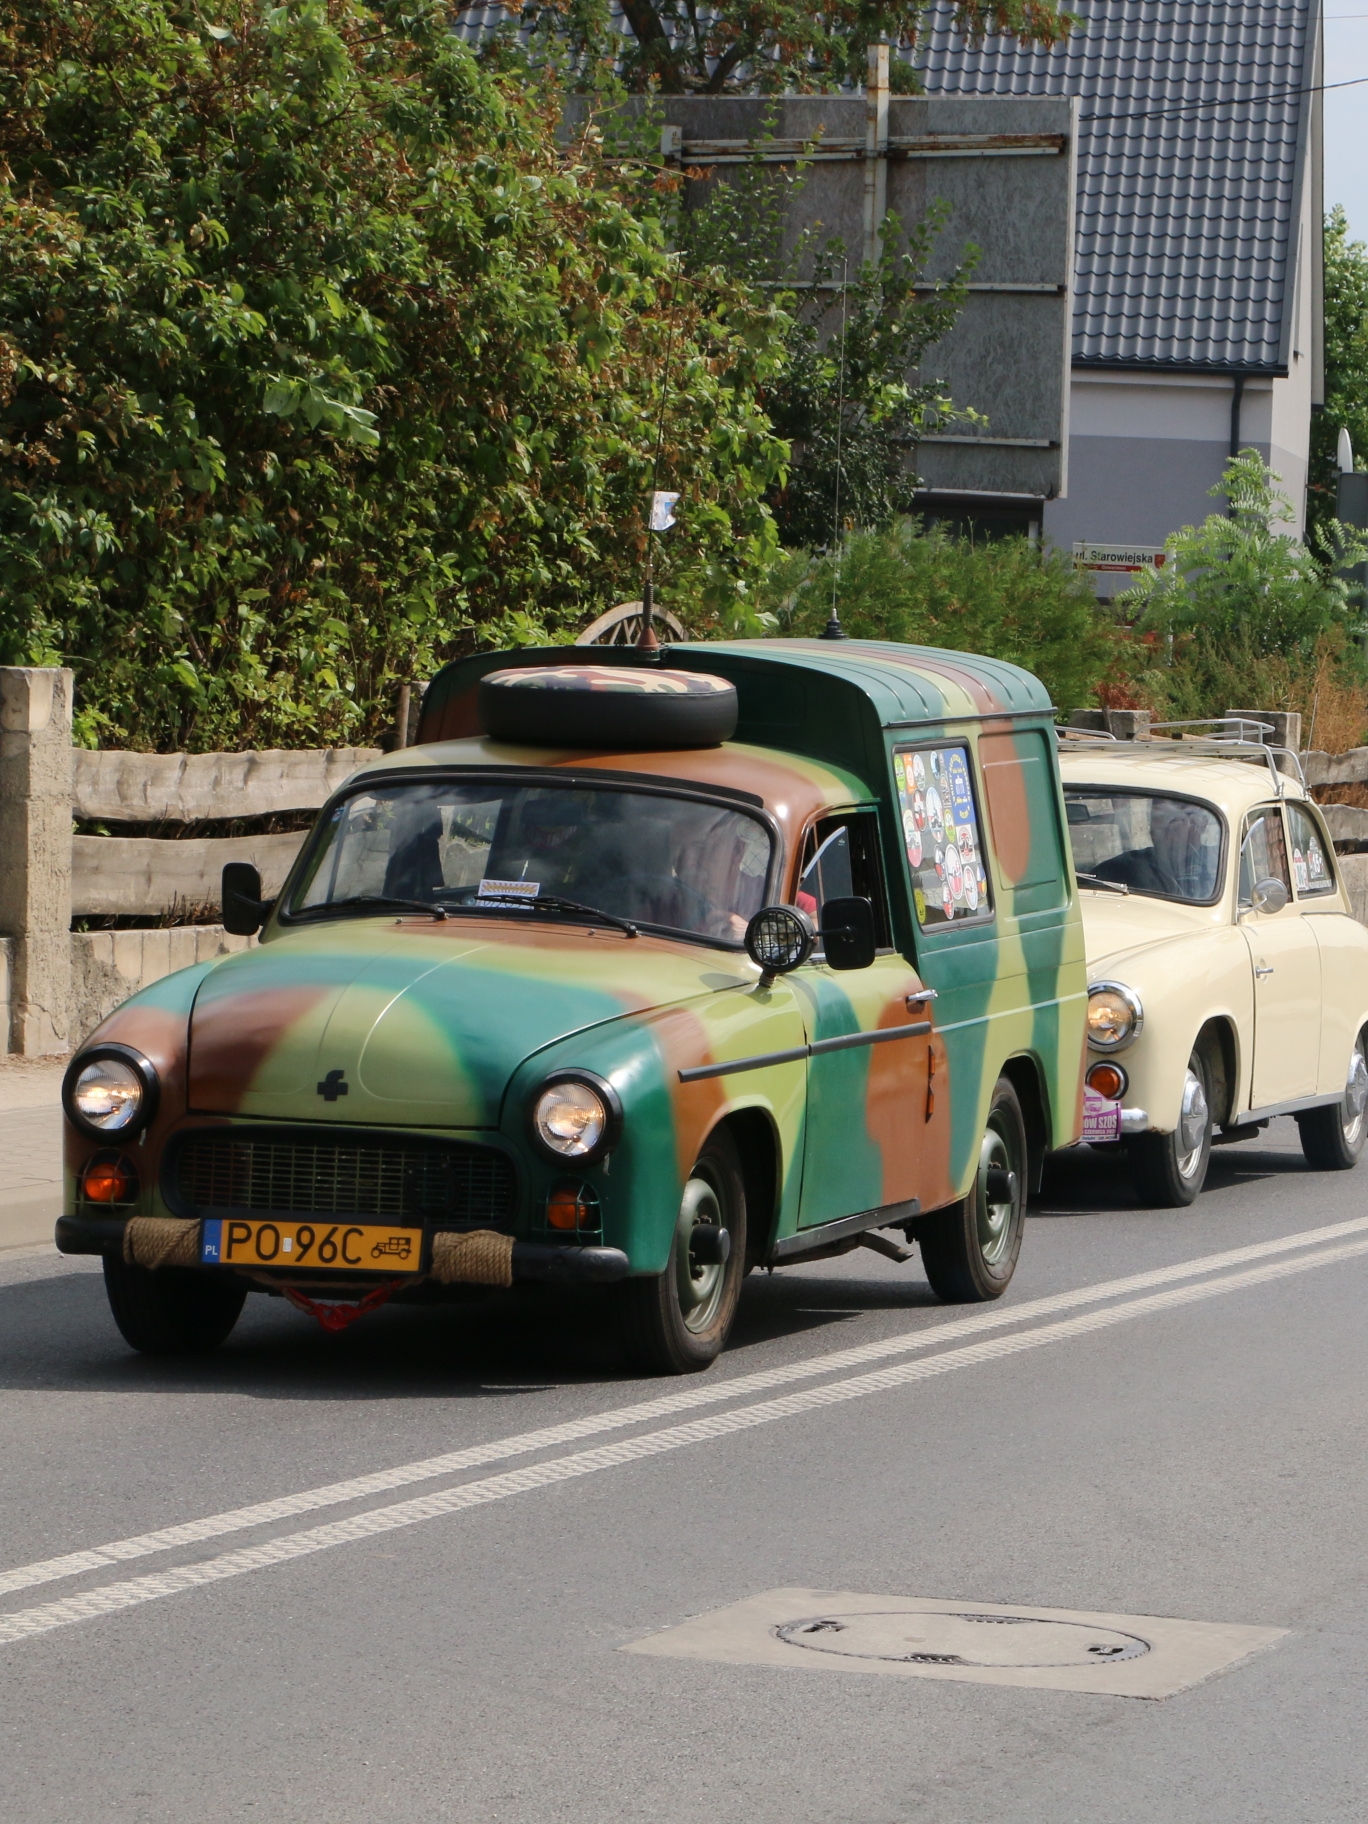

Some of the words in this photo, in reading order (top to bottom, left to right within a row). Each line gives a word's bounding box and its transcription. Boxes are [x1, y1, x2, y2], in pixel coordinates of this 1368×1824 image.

[1091, 550, 1153, 565] Starowiejska
[204, 1245, 218, 1256] PL
[226, 1222, 280, 1261] PO
[295, 1225, 364, 1265] 96C
